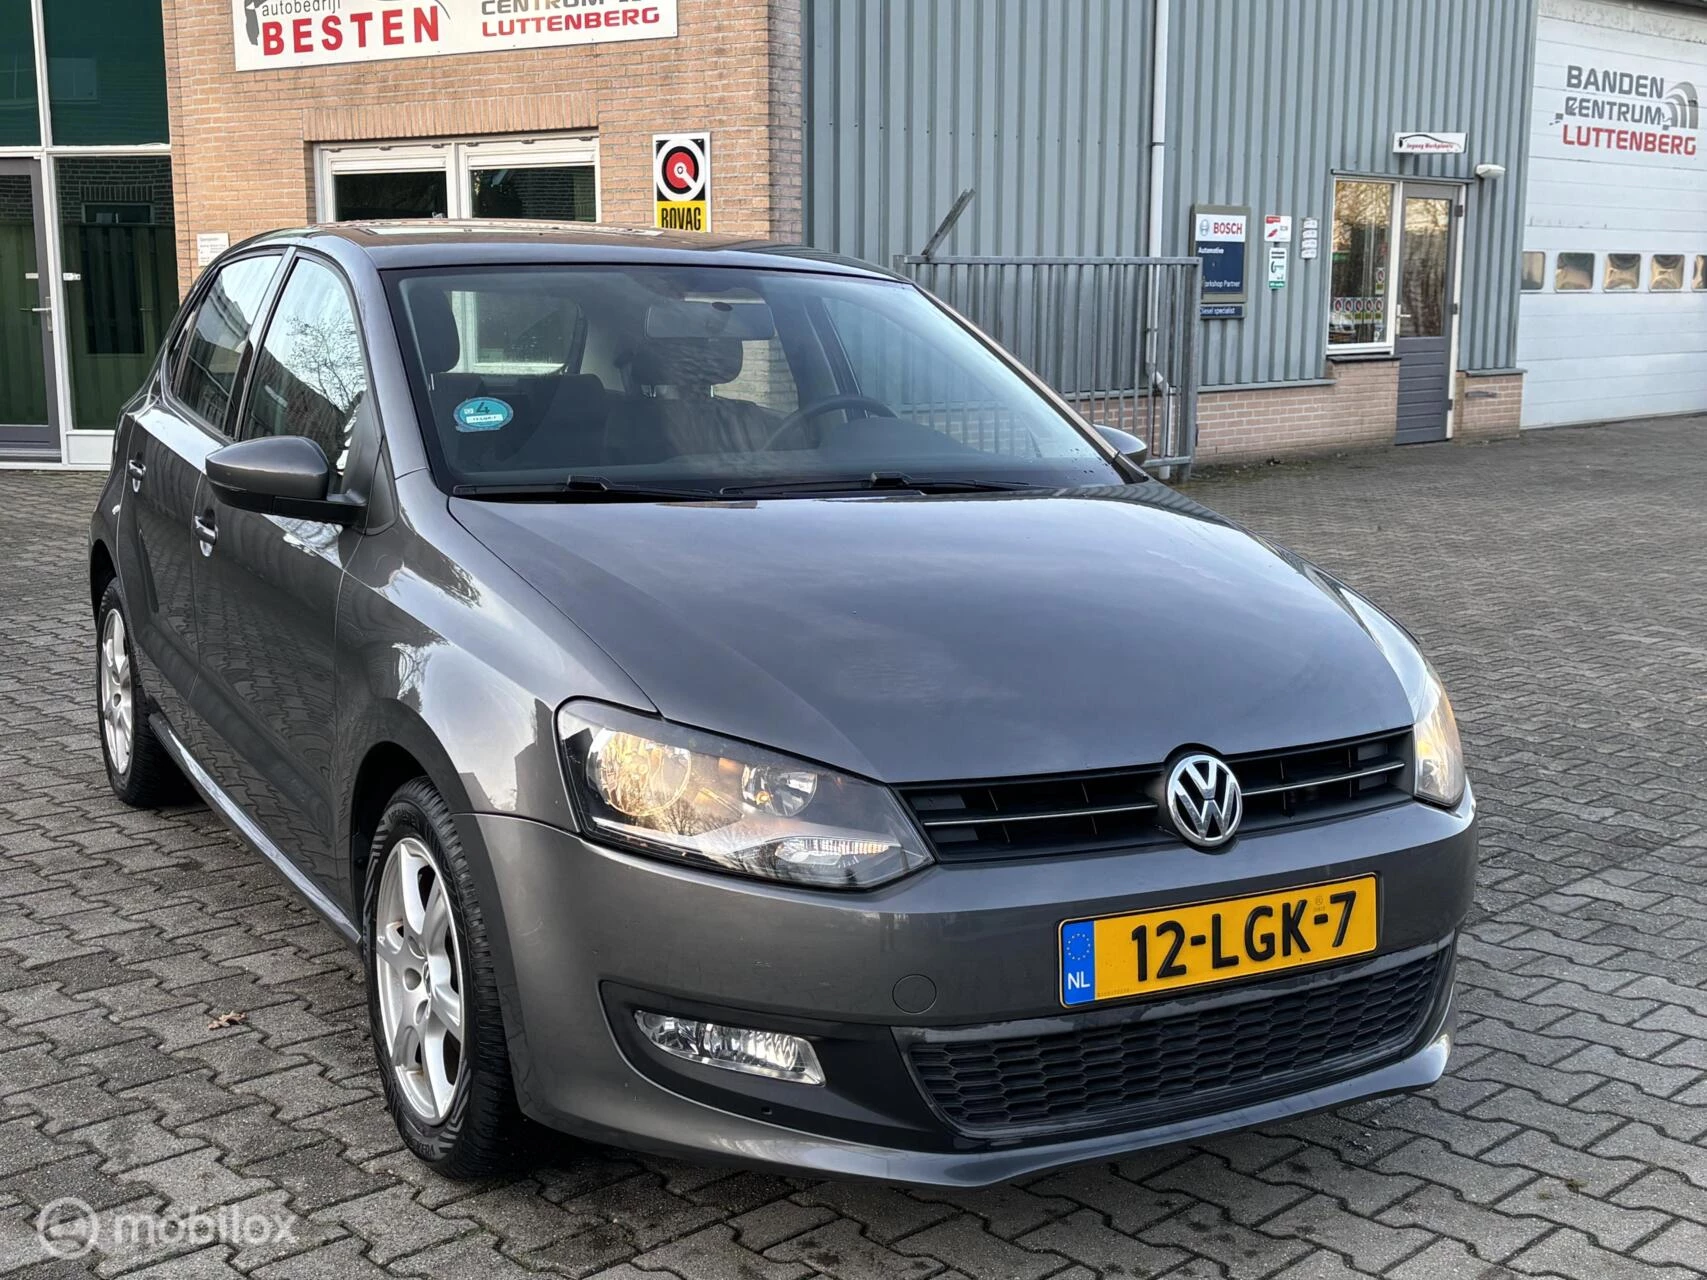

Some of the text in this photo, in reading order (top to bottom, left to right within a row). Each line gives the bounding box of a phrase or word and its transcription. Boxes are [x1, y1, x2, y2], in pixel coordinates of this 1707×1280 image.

[262, 6, 439, 56] BESTEN
[482, 7, 660, 37] LUTTENBERG
[1566, 65, 1664, 99] BANDEN
[1565, 96, 1662, 126] CENTRUM
[1562, 124, 1697, 156] LUTTENBERG
[1213, 222, 1243, 235] BOSCH
[1198, 246, 1224, 254] Automotive
[1223, 280, 1241, 288] Partner
[1131, 890, 1357, 982] 12-LGK-7
[1067, 970, 1090, 990] NL
